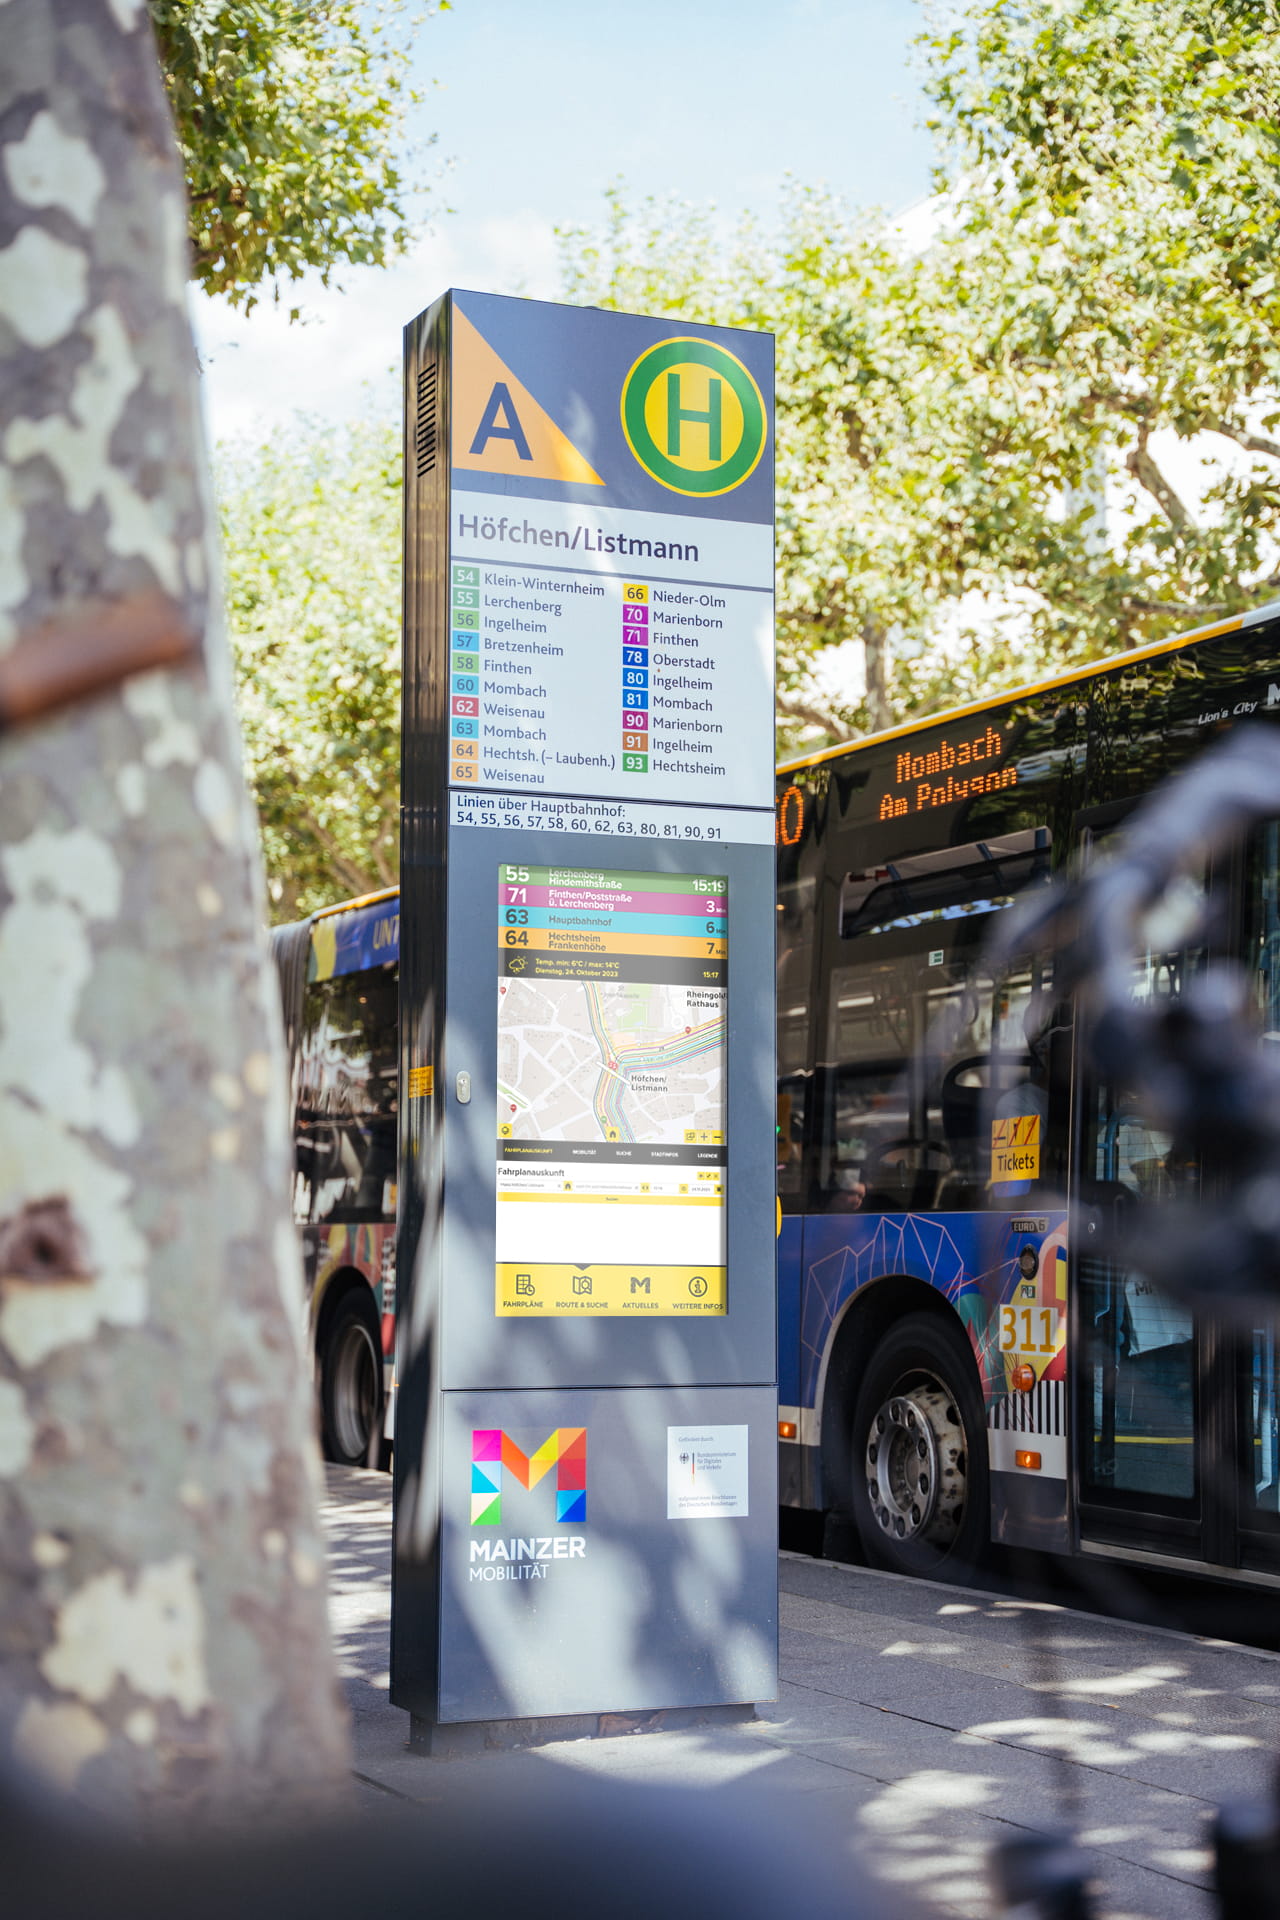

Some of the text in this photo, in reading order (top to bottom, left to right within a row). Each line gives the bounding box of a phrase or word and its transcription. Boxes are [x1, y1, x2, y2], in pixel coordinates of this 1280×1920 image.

[469, 381, 534, 461] A
[667, 372, 722, 461] H
[459, 514, 699, 561] Höfchen/Listmann
[456, 569, 605, 596] 54 Klein-Winternheim
[456, 591, 562, 617] 55 Lerchenberg
[627, 587, 726, 608] 66 Nieder-Olm
[457, 613, 547, 633] 56 Ingelheim
[626, 608, 723, 628] 70 Marienborn
[457, 634, 564, 656] 57 Bretzenheim
[626, 629, 699, 647] 71 Finthen
[457, 657, 532, 675] 58 Finthen
[626, 650, 716, 670] 78 Oberstadt
[457, 679, 547, 697] 60 Mombach
[627, 672, 713, 691] 80 Ingelheim
[456, 701, 545, 719] 62 Weisenau
[626, 693, 713, 711] 81 Mombach
[1198, 701, 1258, 725] Lion's City
[456, 722, 547, 740] 63 Mombach
[626, 714, 723, 733] 90 Marienborn
[626, 735, 713, 753] 91 Ingelheim
[456, 744, 474, 757] 64
[484, 746, 539, 762] Hechtsh.
[556, 751, 615, 770] Laubenh.)
[896, 727, 1001, 783] Mombach
[626, 756, 726, 775] 93 Hechtsheim
[456, 766, 545, 784] 65 Weisenau
[457, 795, 626, 817] Linien über Hauptbahnhof:
[776, 784, 804, 845] 0
[880, 794, 908, 820] Am
[457, 811, 722, 840] 54, 55, 56, 57, 58, 60, 62, 63, 80, 81, 90, 91
[505, 866, 530, 883] 55
[549, 877, 623, 891] Hindemithstraße
[692, 879, 726, 894] 15:19
[507, 887, 527, 904] 71
[549, 889, 632, 903] Finthen/Poststraße
[559, 900, 614, 911] Lerchenberg
[705, 901, 715, 913] 3
[505, 908, 529, 925] 63
[549, 915, 612, 928] Hauptbahnhof
[705, 922, 715, 934] 6
[505, 930, 528, 947] 64
[549, 932, 601, 944] Hechtsheim
[549, 940, 606, 952] Frankenhöhe
[706, 942, 715, 955] 7
[686, 1000, 719, 1008] Rathaus
[631, 1084, 668, 1092] Listmann
[997, 1152, 1035, 1172] Tickets
[497, 1167, 565, 1178] Fahrplanauskunft
[1013, 1220, 1046, 1232] EURO 6
[503, 1300, 544, 1309] FAHRPLÄNE
[555, 1301, 580, 1309] ROUTE
[586, 1302, 609, 1310] SUCHE
[622, 1302, 659, 1310] AKTUELLES
[672, 1302, 724, 1311] WEITERE INFOS
[1002, 1306, 1055, 1353] 311
[469, 1536, 586, 1562] MAINZER
[469, 1562, 550, 1582] MOBILITÄT
